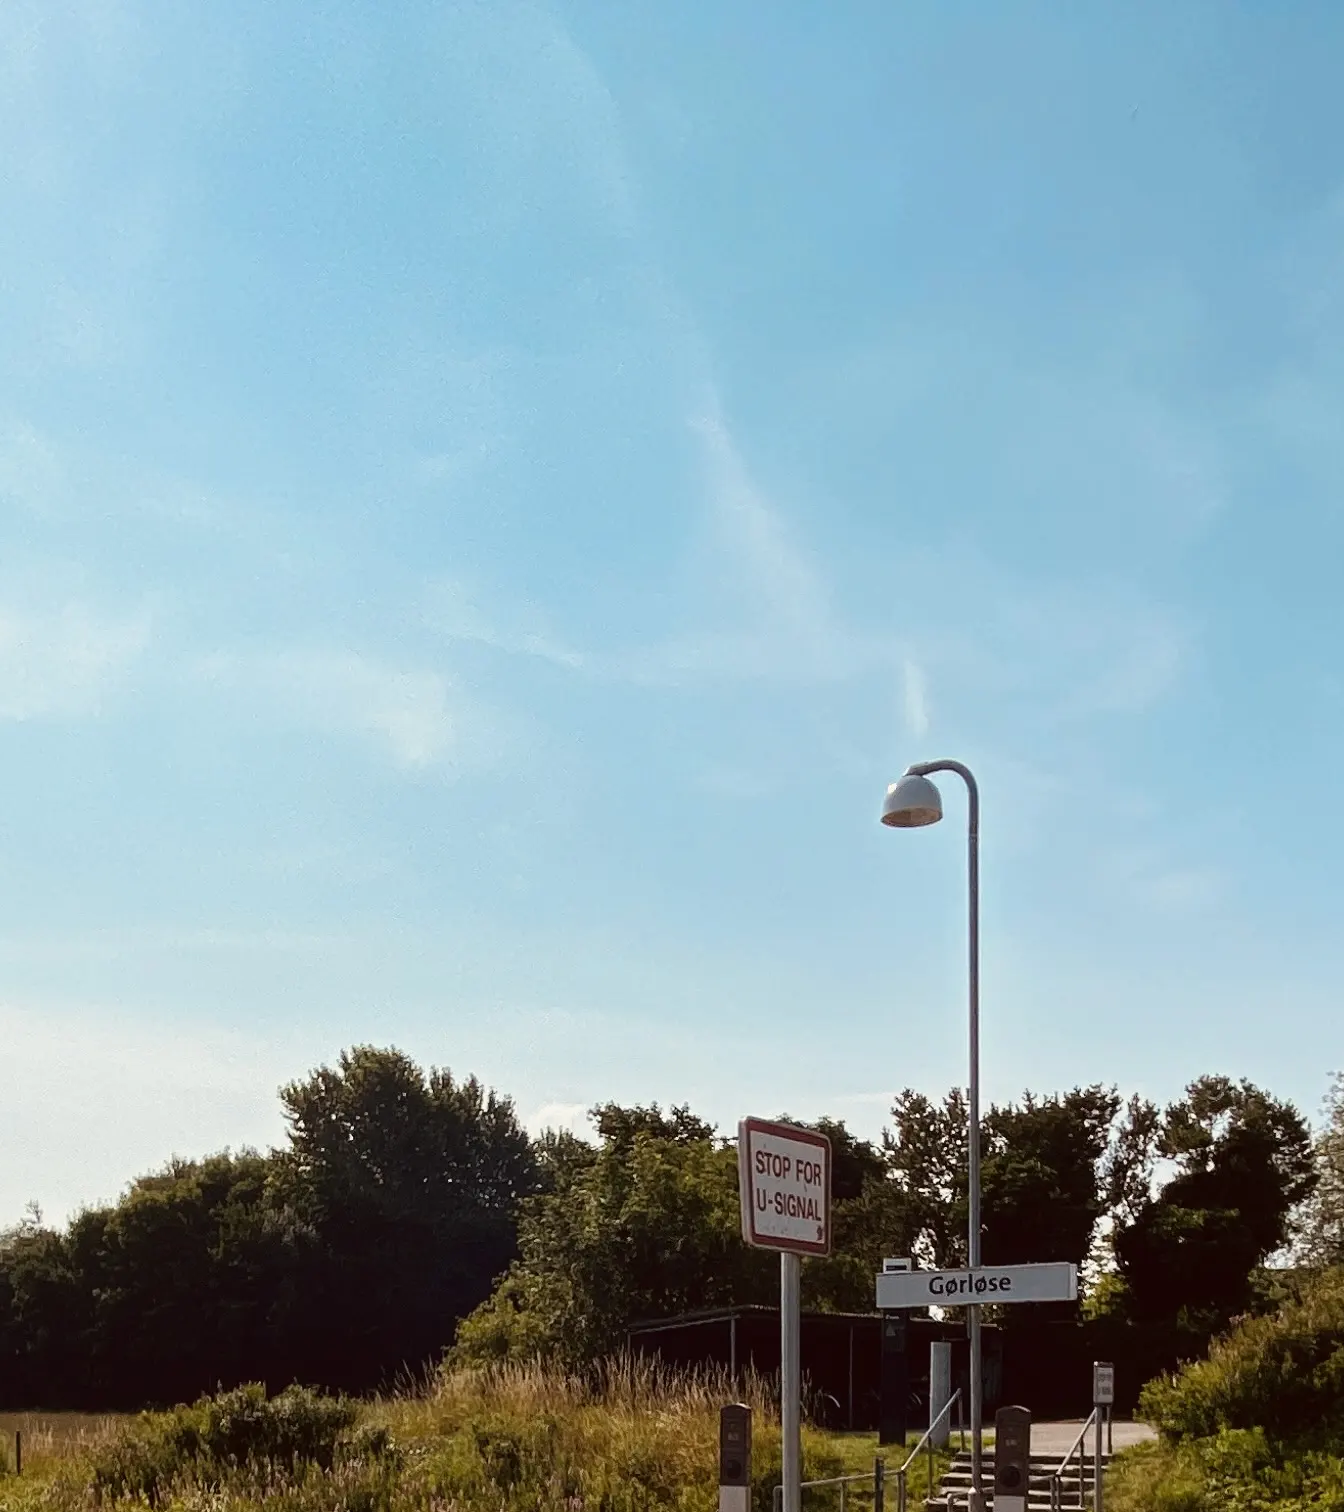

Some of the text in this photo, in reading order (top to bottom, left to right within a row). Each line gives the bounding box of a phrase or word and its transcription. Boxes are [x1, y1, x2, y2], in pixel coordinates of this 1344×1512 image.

[756, 1150, 821, 1186] STOP FOR
[756, 1188, 821, 1221] U-SIGNAL
[929, 1273, 1011, 1296] Gørløse
